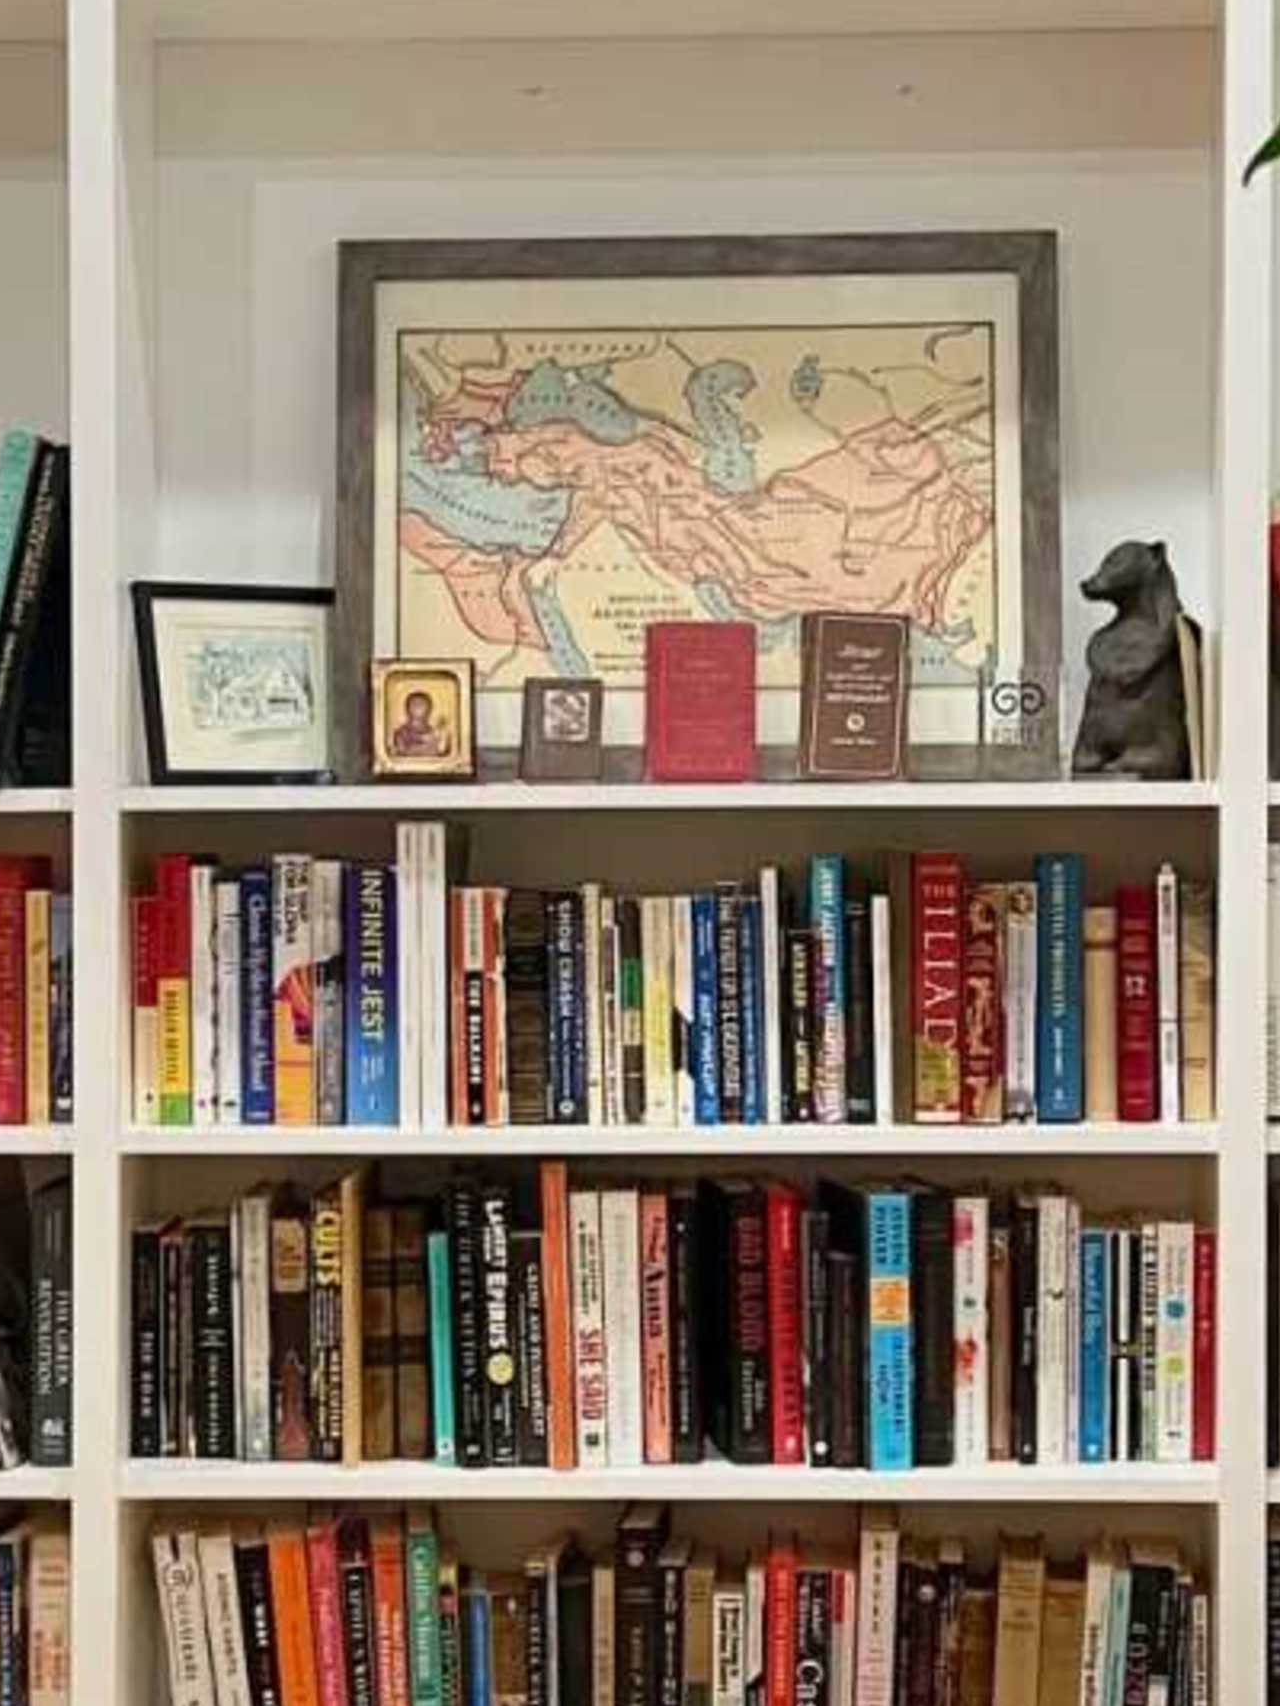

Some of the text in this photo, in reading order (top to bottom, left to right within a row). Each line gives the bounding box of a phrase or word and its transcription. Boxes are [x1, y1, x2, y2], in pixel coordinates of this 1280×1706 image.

[360, 869, 384, 1043] INFINITE JEST
[558, 900, 572, 1017] SNOW CRASH
[923, 907, 958, 1045] ILIAD
[469, 1015, 482, 1083] BALKANS
[315, 1209, 341, 1285] CULTS
[738, 1216, 763, 1350] BAD BLOOD
[37, 1278, 52, 1394] REVOLUTION
[485, 1271, 508, 1349] EPIRUS
[644, 1266, 665, 1338] Anna
[579, 1327, 606, 1420] SHE SAID
